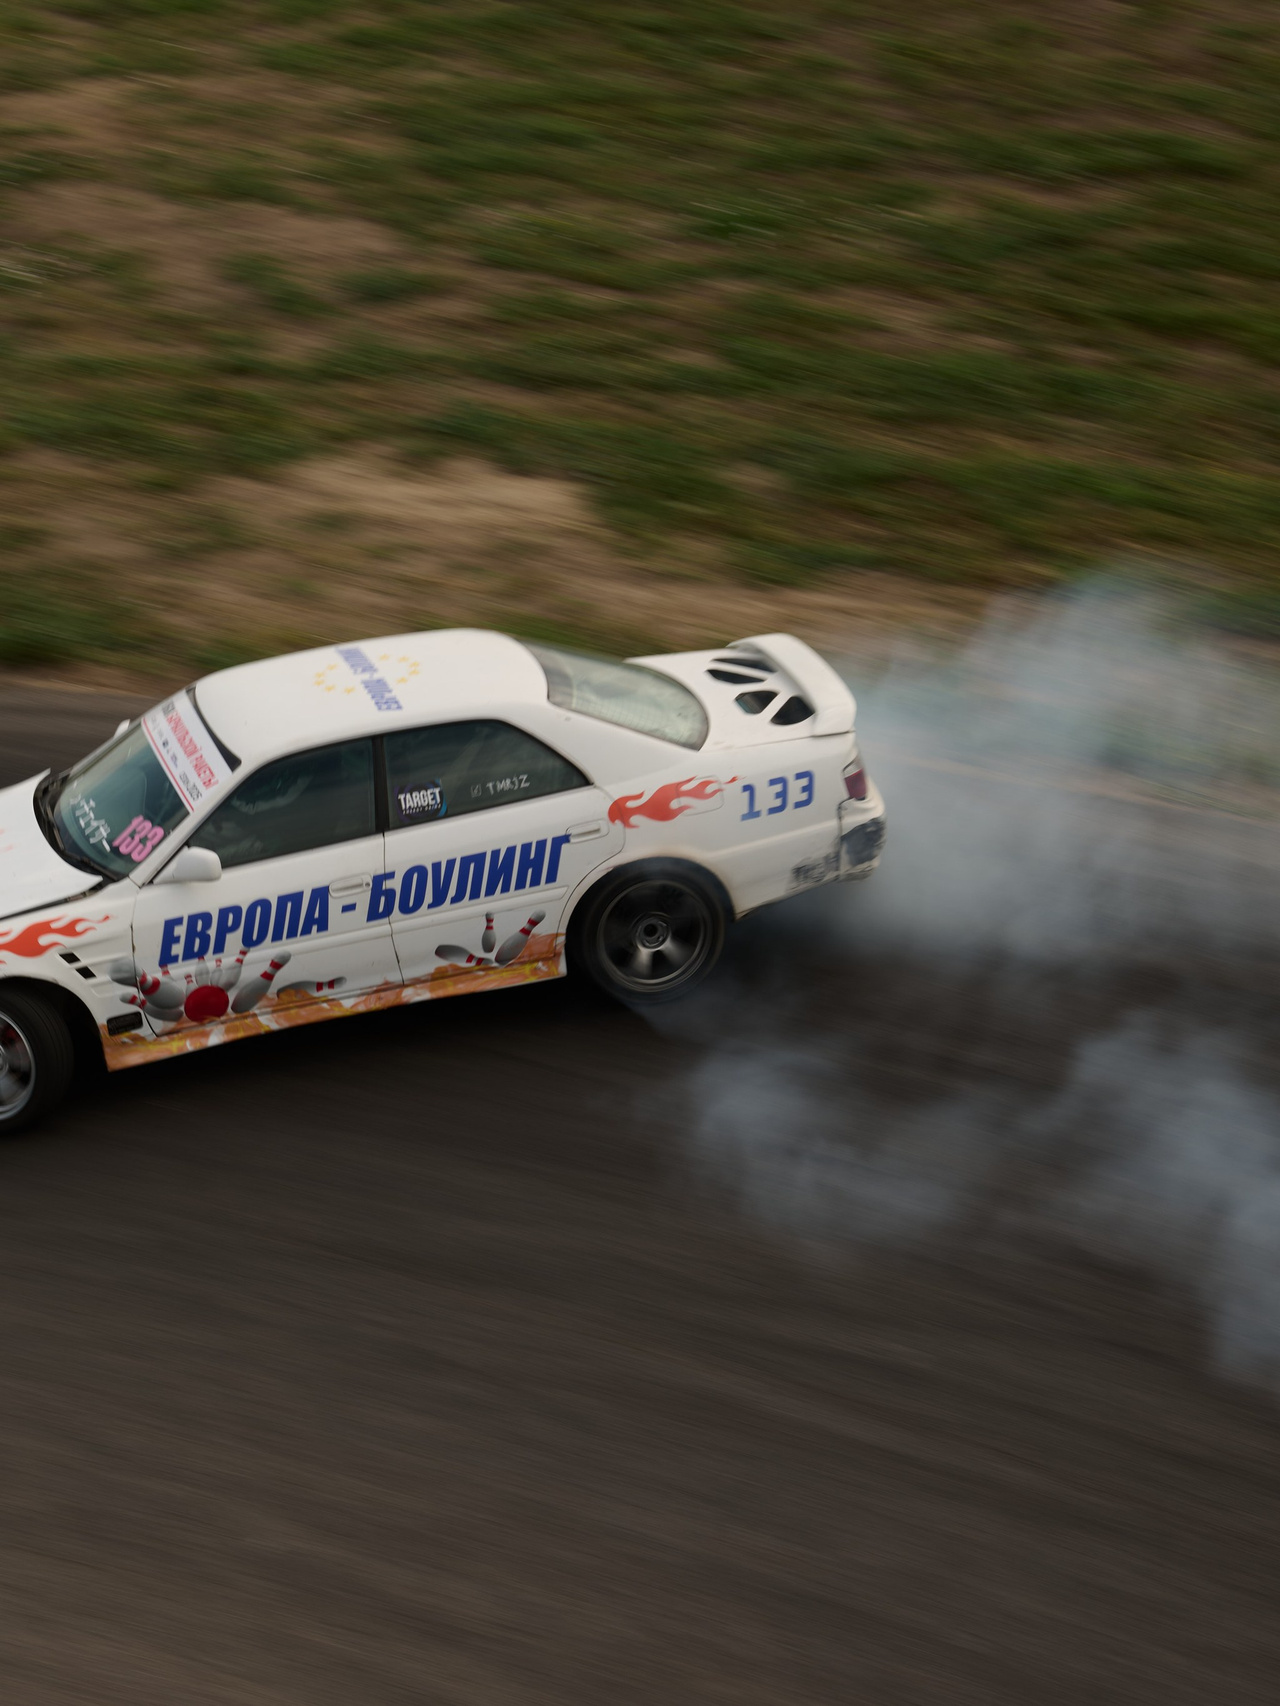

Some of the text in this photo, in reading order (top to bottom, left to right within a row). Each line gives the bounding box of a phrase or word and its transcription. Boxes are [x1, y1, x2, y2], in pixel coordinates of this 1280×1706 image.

[398, 787, 441, 811] TARGET
[741, 770, 814, 821] 133
[112, 815, 164, 862] 133
[158, 885, 329, 967] ЕВРОПА
[366, 834, 571, 923] БОУЛИНГ
